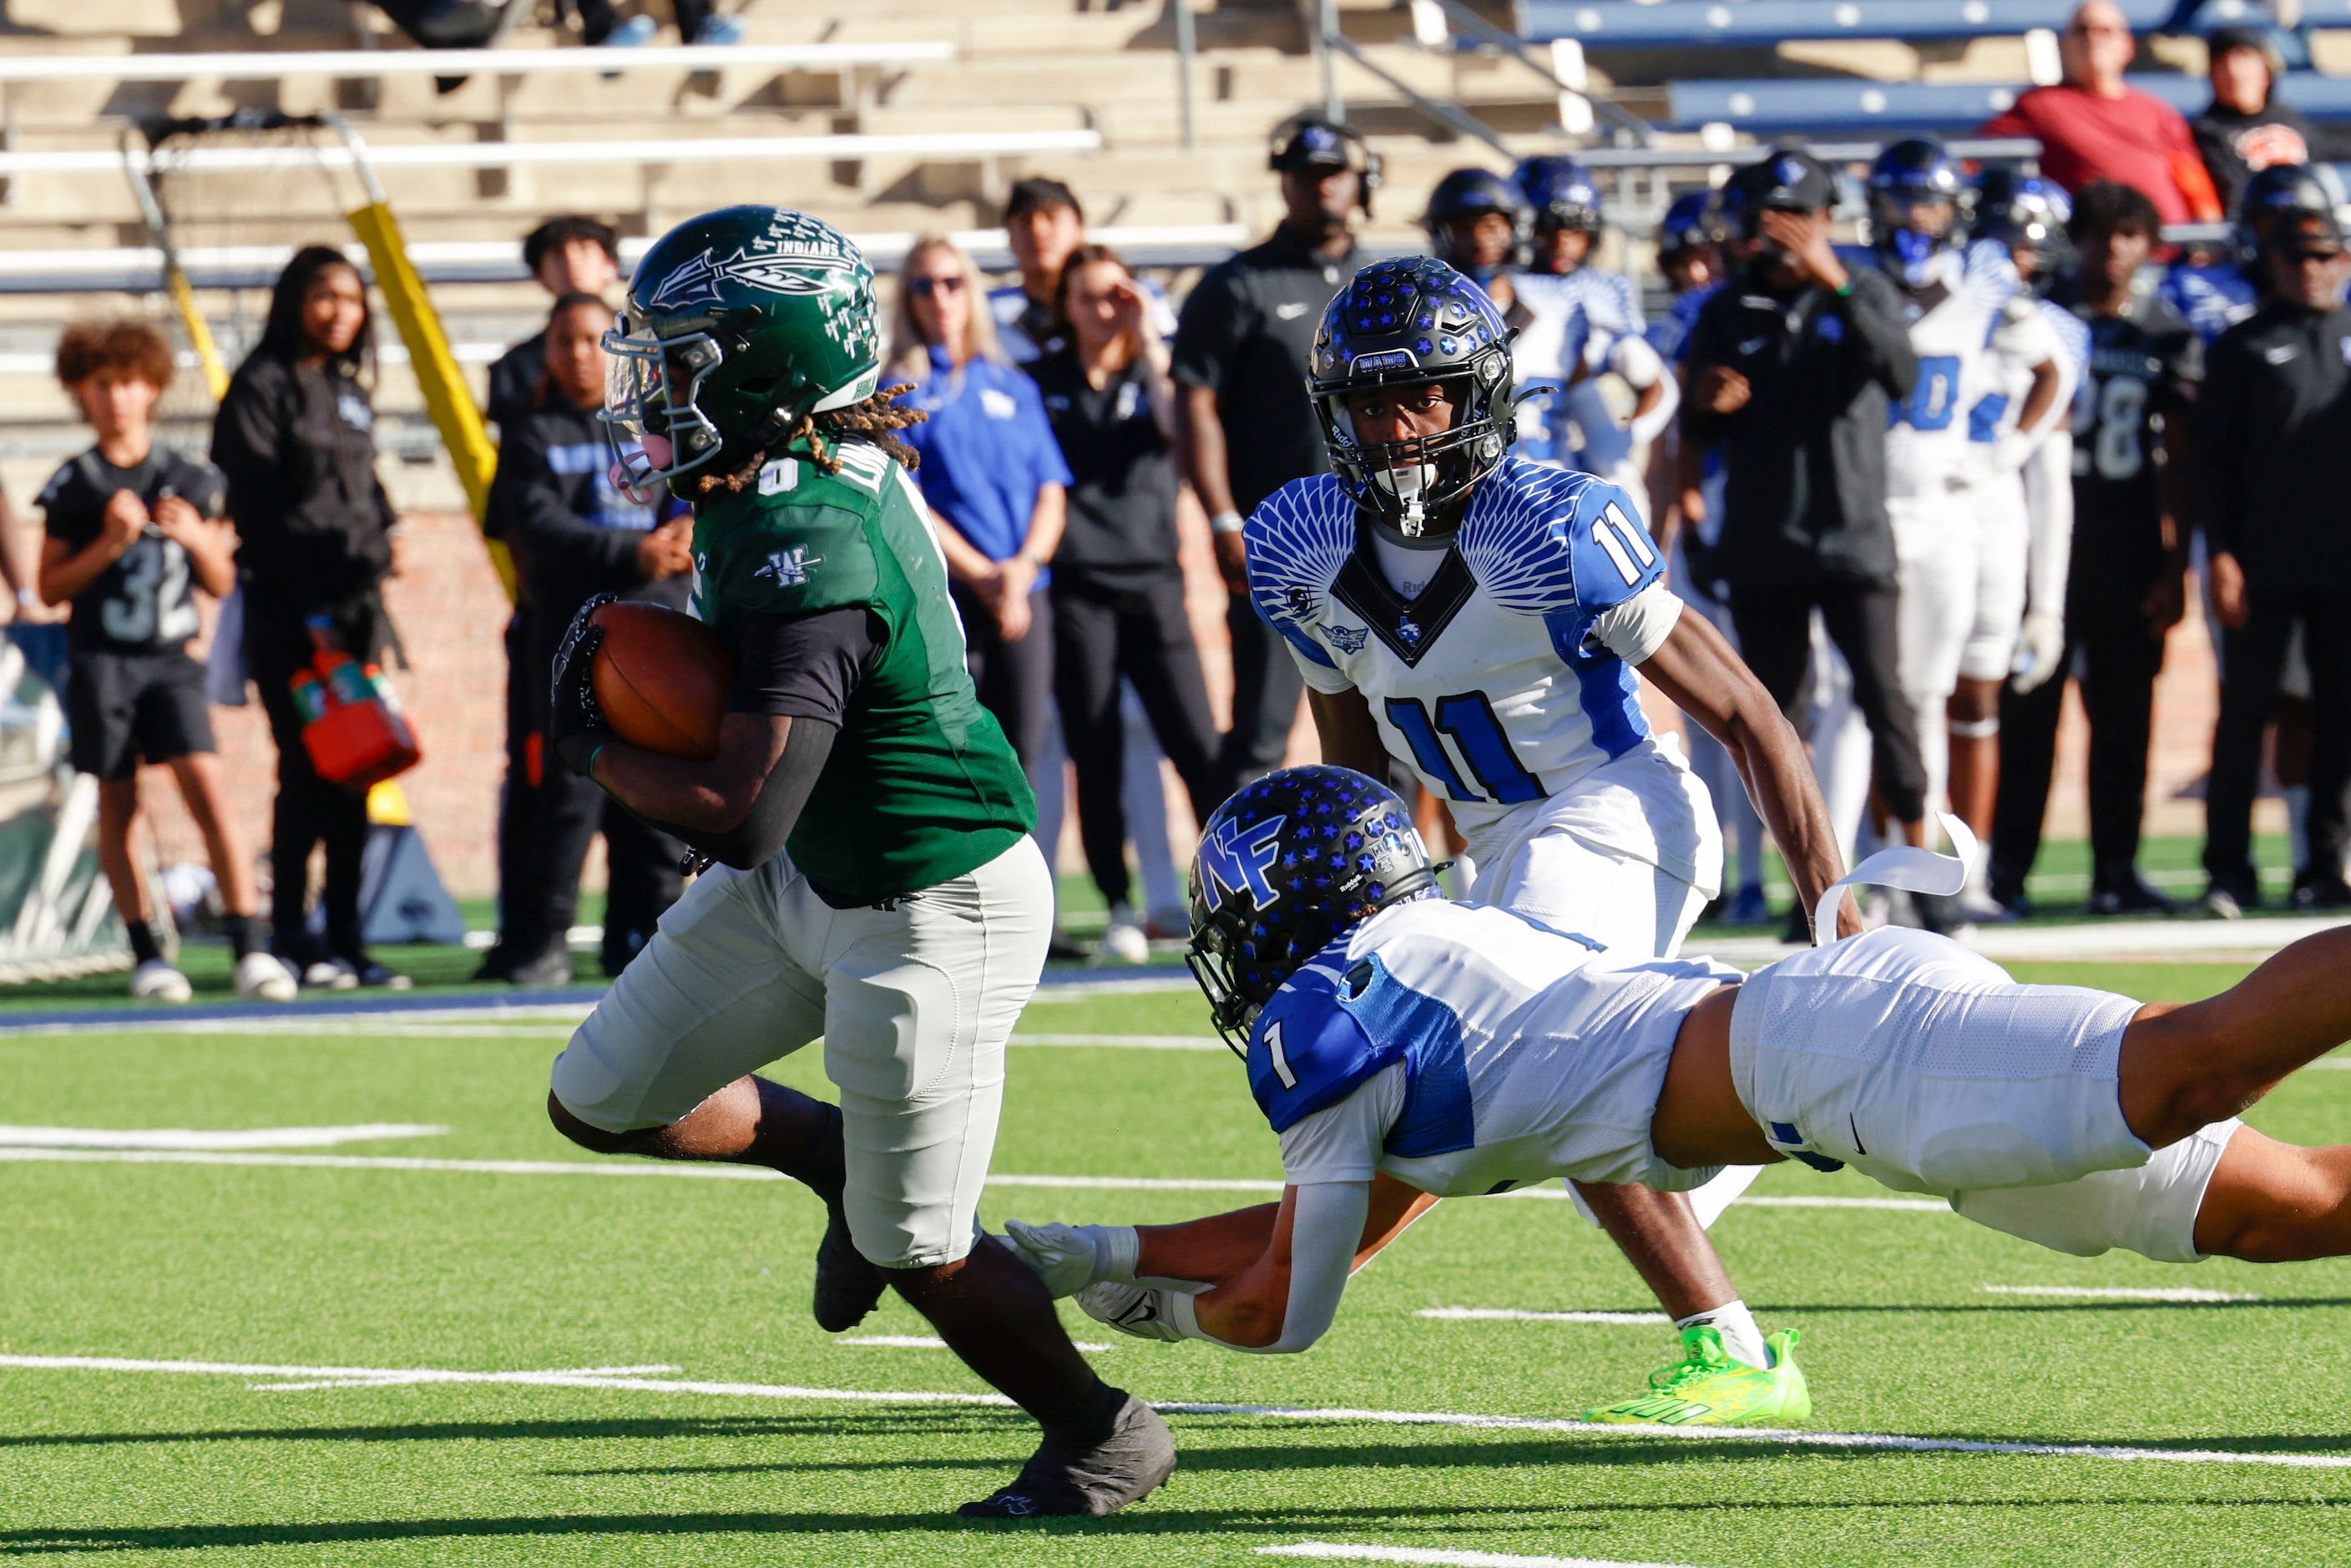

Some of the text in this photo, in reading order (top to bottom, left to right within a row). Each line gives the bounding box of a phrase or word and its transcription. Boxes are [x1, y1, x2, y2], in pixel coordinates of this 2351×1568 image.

[776, 240, 839, 256] INDIANS
[1358, 352, 1408, 373] WAWG
[1590, 499, 1656, 589] 11
[101, 536, 200, 643] 32
[1383, 689, 1550, 805] 11
[1197, 814, 1287, 913] NF
[1340, 874, 1363, 893] Riddell
[1263, 1020, 1297, 1090] 1
